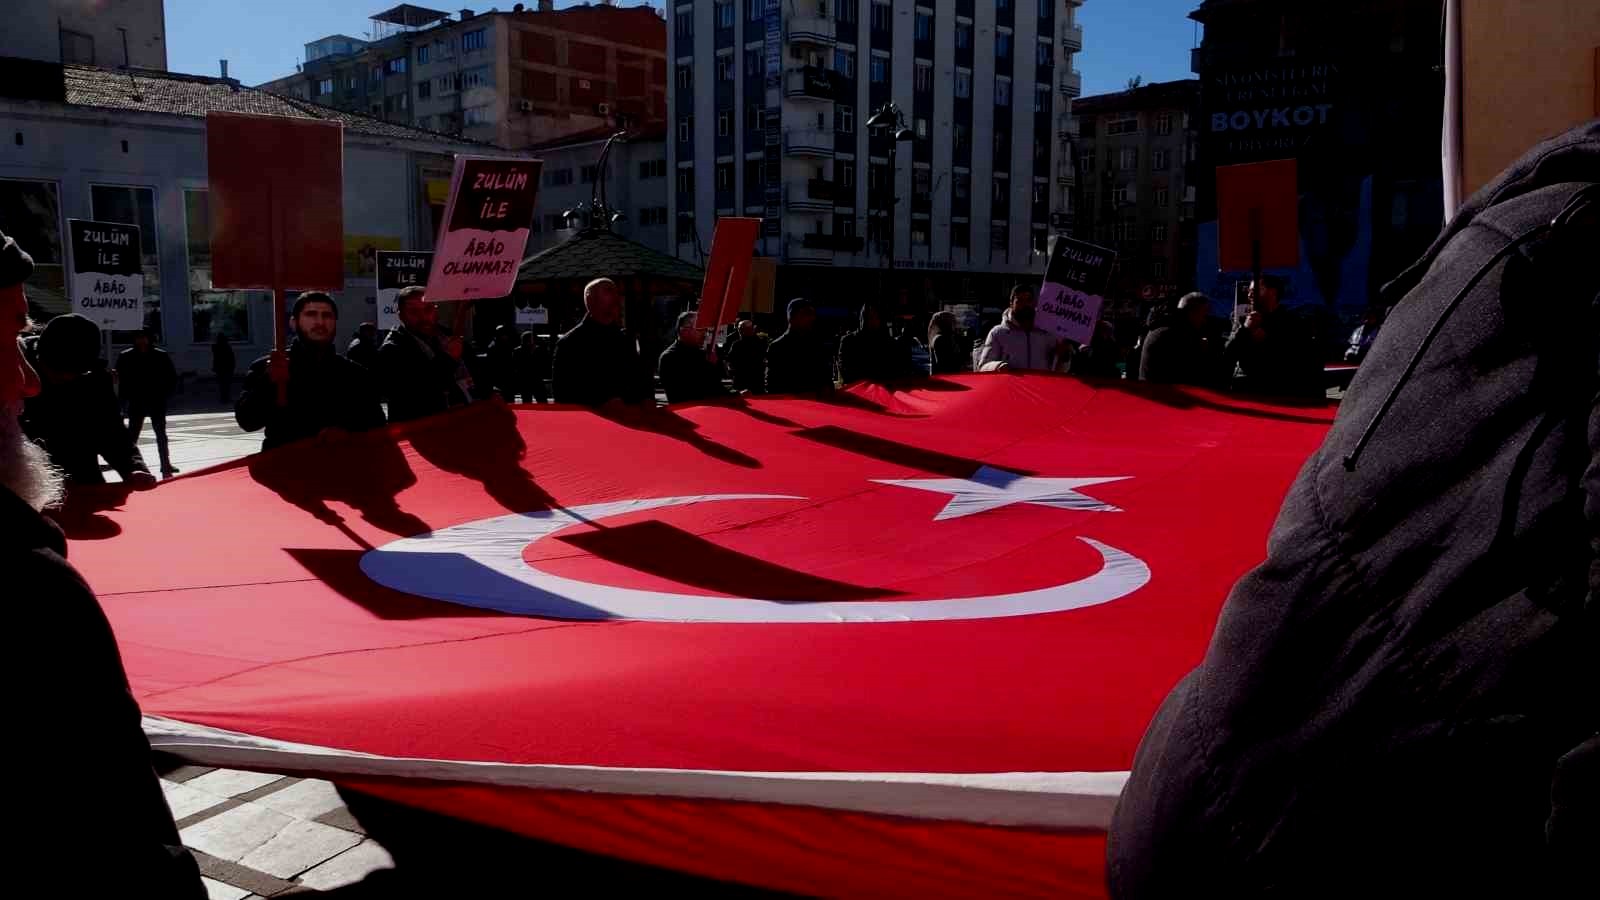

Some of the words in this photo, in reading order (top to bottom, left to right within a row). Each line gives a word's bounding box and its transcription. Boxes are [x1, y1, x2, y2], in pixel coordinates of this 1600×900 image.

[1209, 103, 1335, 133] BOYKOT
[472, 167, 528, 191] ZULÜM
[480, 196, 509, 219] İLE
[83, 228, 129, 247] ZULÜM
[97, 248, 120, 266] İLE
[386, 256, 425, 269] ZULÜM
[1062, 246, 1103, 268] ZULÜM
[442, 260, 514, 275] OLUNMAZ!
[81, 297, 137, 309] OLUNMAZ!
